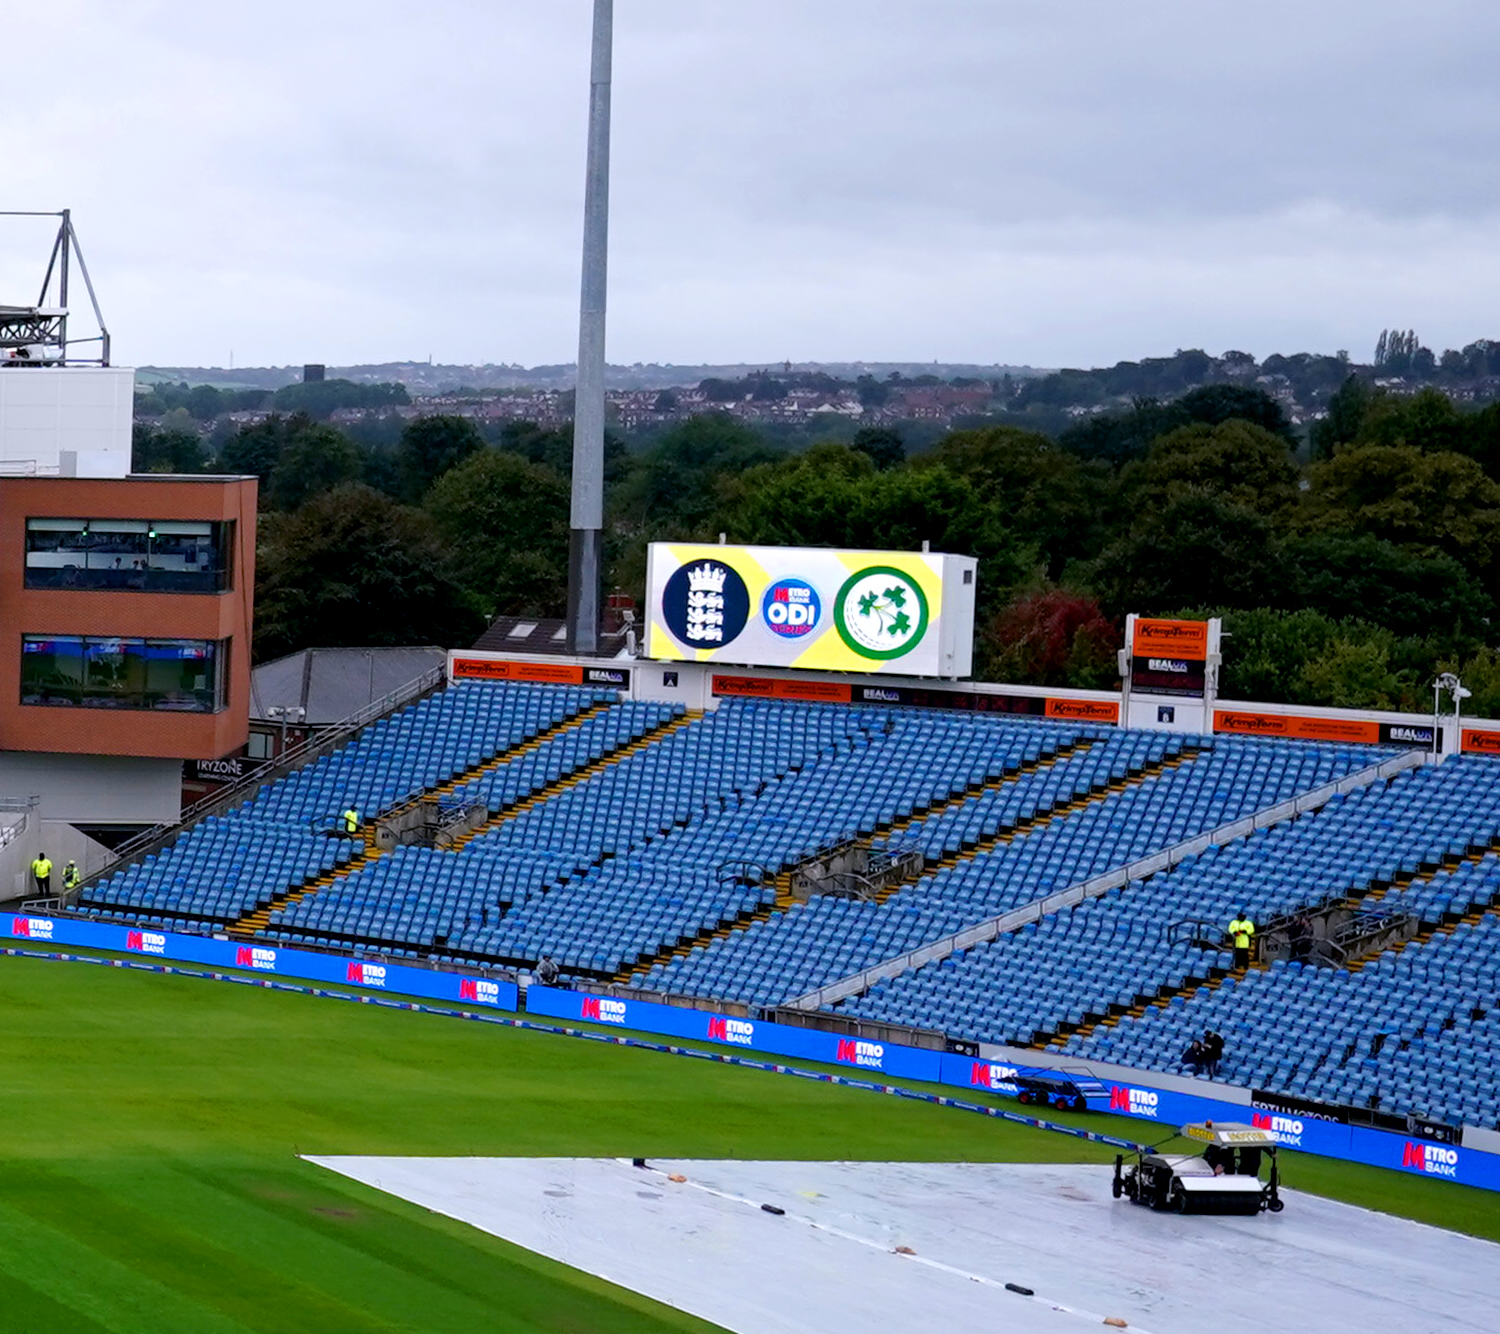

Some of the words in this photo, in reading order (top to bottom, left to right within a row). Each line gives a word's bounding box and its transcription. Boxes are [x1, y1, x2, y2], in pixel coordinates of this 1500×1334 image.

[768, 602, 816, 626] ODI
[14, 918, 53, 936] METRO
[30, 929, 52, 938] BANK
[348, 963, 386, 982] METRO
[363, 976, 384, 986] BANK
[838, 1040, 883, 1062] METRO
[856, 1055, 882, 1068] BANK
[1403, 1142, 1457, 1169] METRO
[1426, 1161, 1456, 1177] BANK
